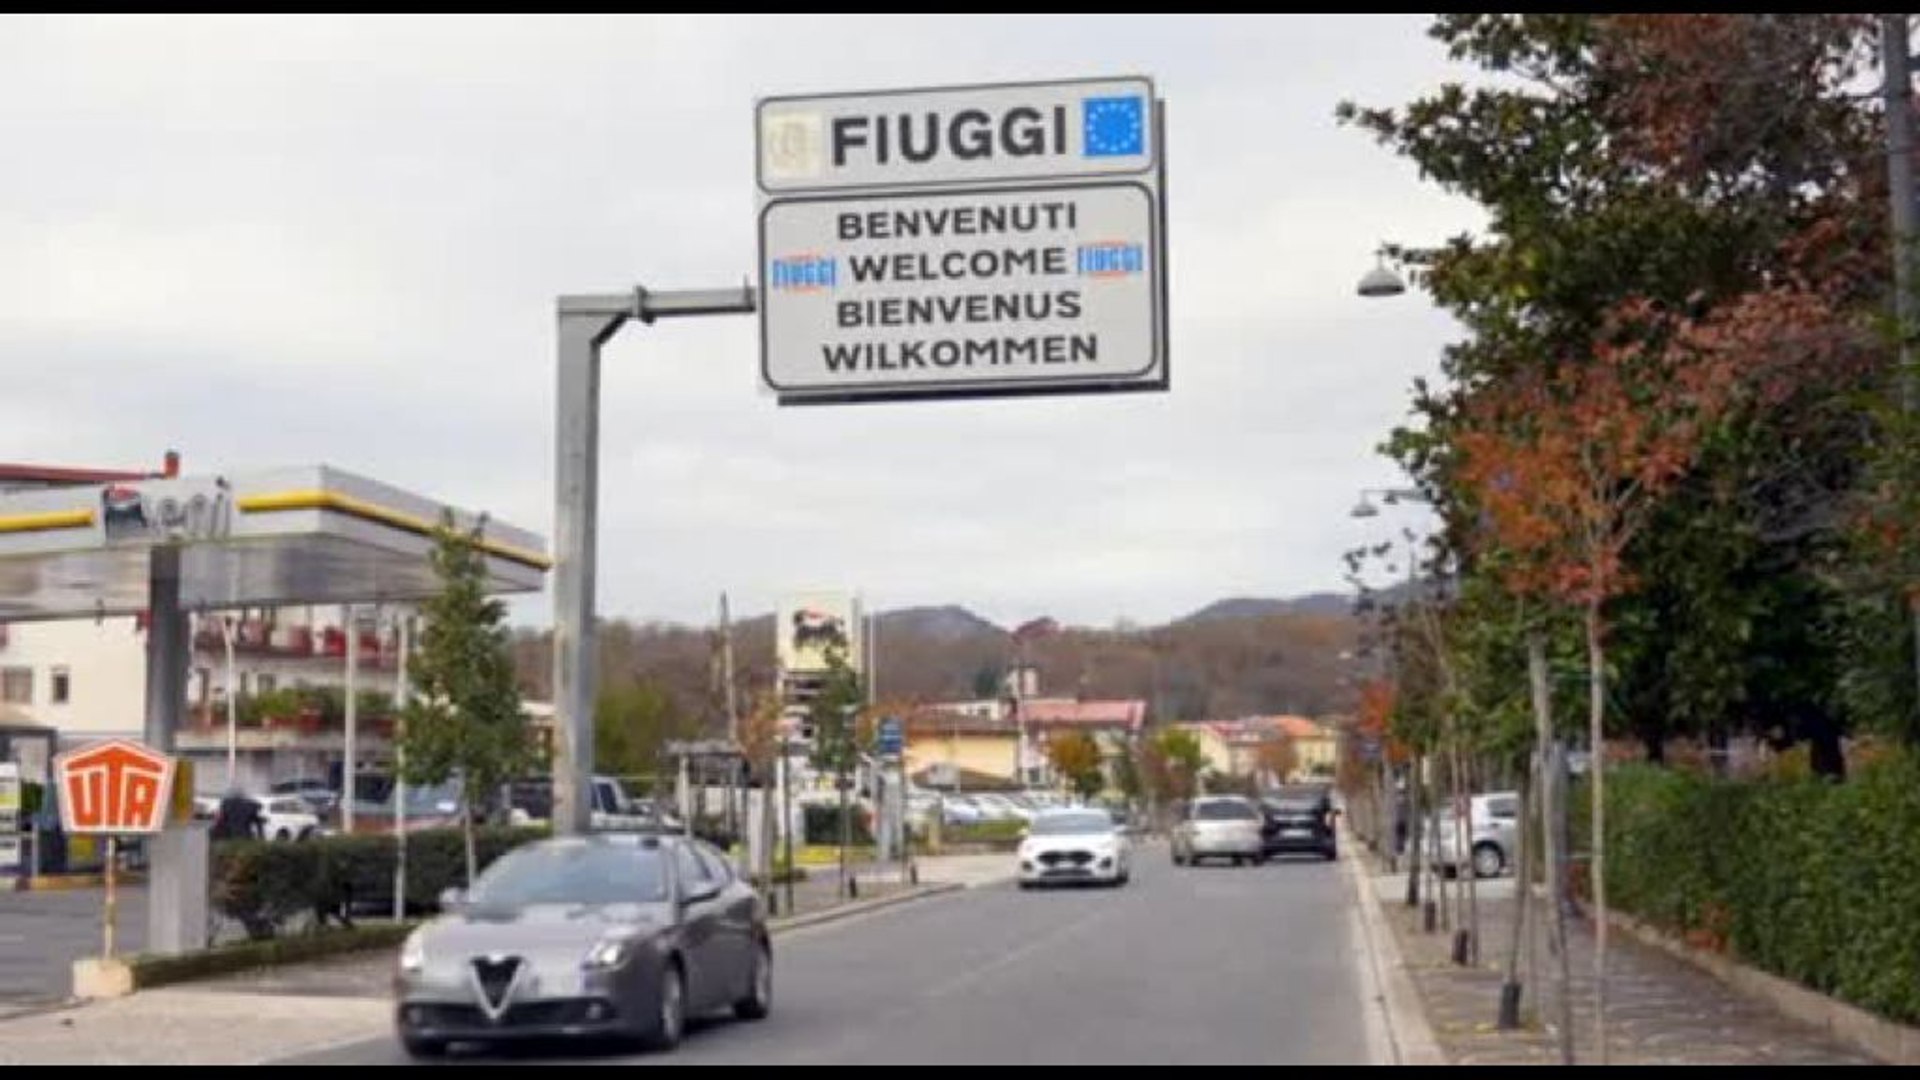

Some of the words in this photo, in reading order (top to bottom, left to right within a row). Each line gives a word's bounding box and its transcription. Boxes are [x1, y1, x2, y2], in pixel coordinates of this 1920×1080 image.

[831, 105, 1067, 166] FIUGGI
[837, 202, 1077, 239] BENVENUTI
[849, 247, 1067, 282] WELCOME
[837, 290, 1082, 327] BIENVENUS
[822, 333, 1098, 372] WILKOMMEN
[66, 745, 165, 829] UTA
